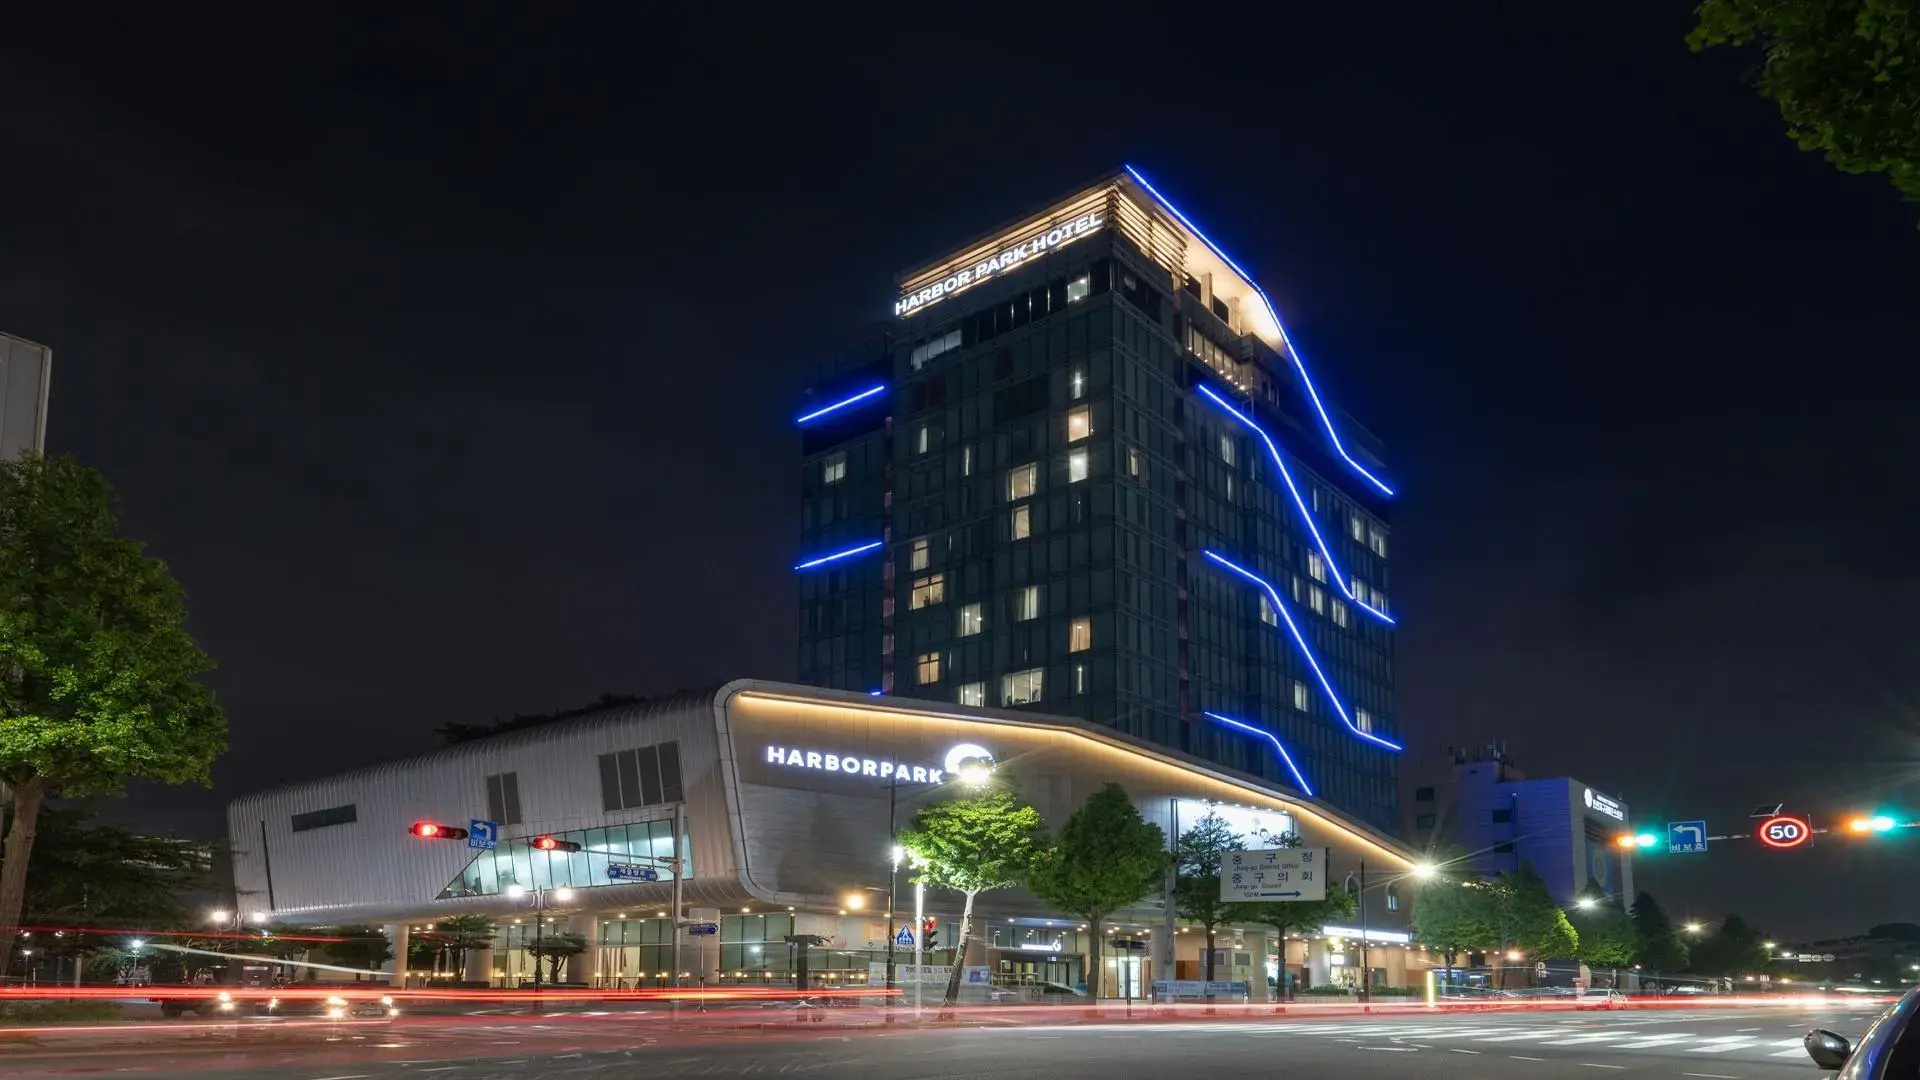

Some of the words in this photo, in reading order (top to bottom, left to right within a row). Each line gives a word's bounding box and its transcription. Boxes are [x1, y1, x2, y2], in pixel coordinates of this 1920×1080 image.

[895, 270, 973, 316] HARBOR
[975, 245, 1029, 279] PARK
[1032, 213, 1103, 253] HOTEL
[767, 745, 945, 785] HARBORPARK
[1769, 824, 1798, 839] 50
[470, 838, 497, 848] 비보호
[1671, 842, 1705, 851] 비보호
